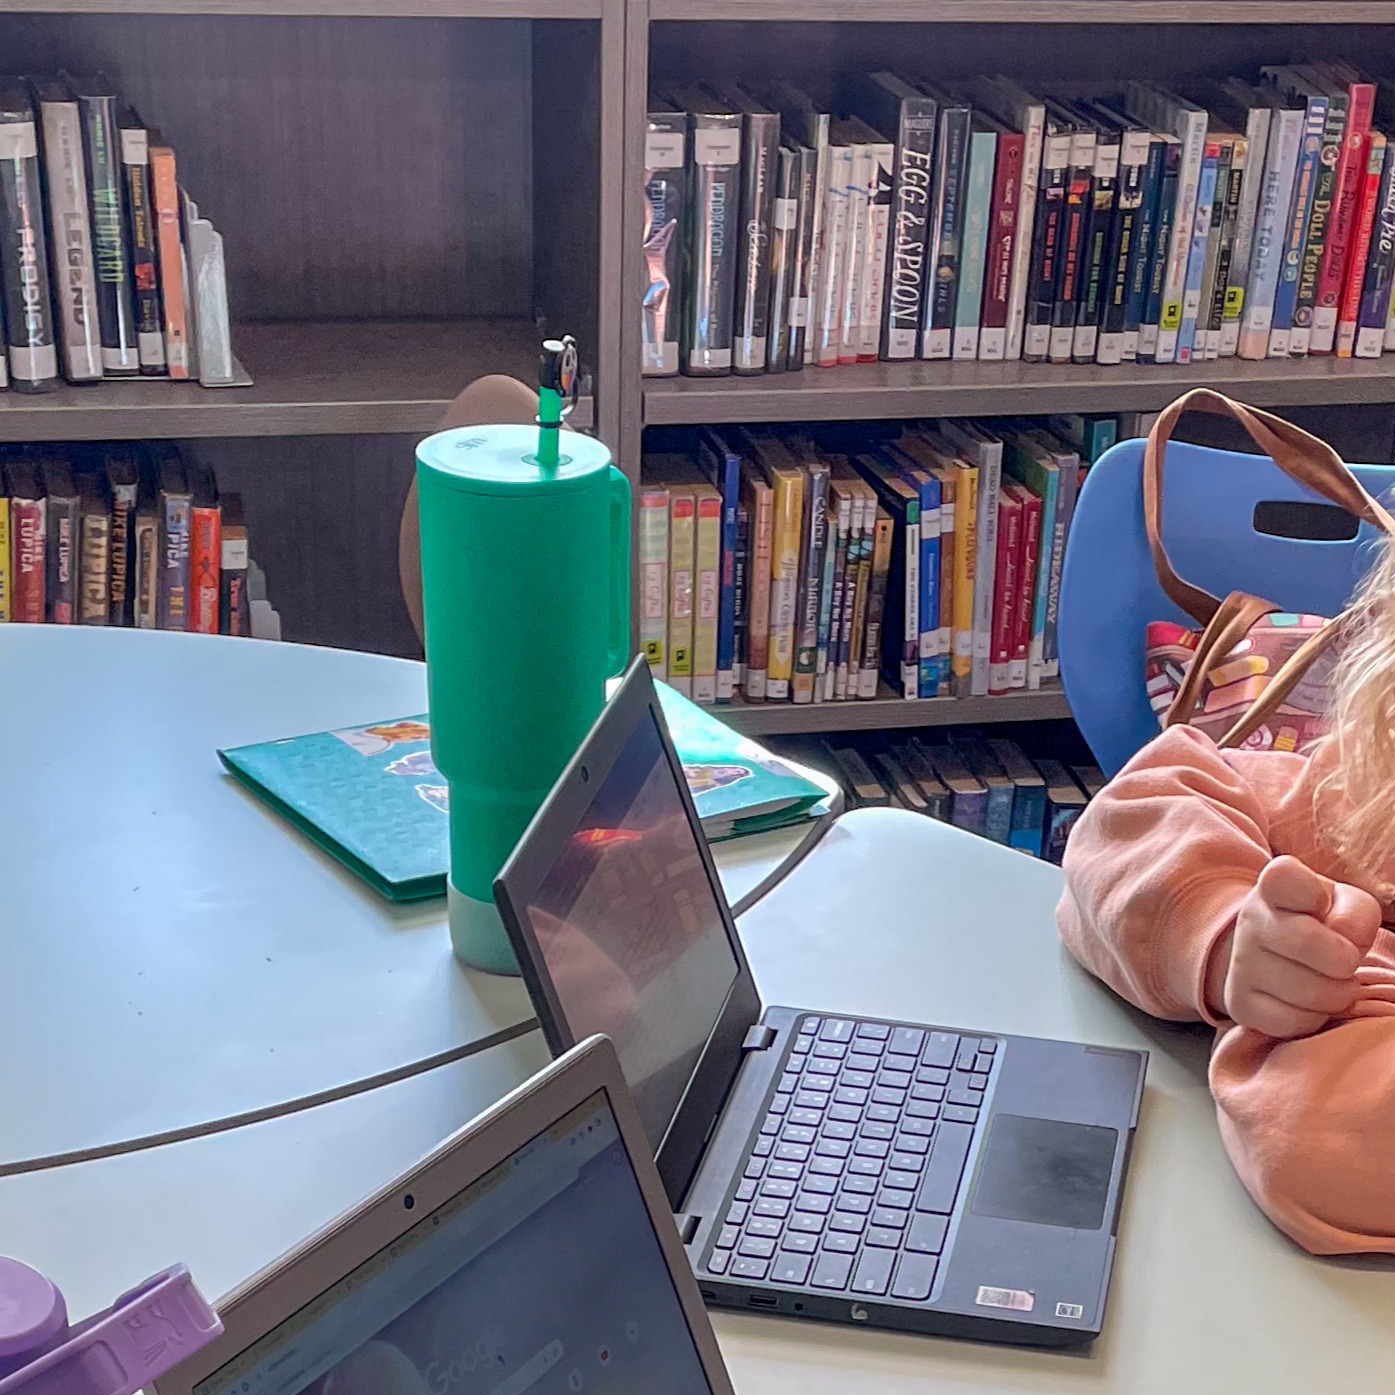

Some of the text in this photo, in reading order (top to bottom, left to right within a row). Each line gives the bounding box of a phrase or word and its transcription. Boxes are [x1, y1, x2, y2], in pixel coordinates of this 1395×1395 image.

[710, 183, 726, 257] PENDRAGON
[1229, 171, 1240, 203] MARTIN
[1308, 199, 1329, 240] DOLL
[93, 188, 124, 283] WILDCARD
[891, 147, 931, 321] EGG & SPOON
[1139, 224, 1150, 253] NIGHT
[1151, 224, 1168, 294] NIGHT TOURIST
[1254, 171, 1279, 283] HERE TODAY
[17, 228, 43, 347] PRODIGY
[64, 212, 84, 326] LEGEND
[1299, 244, 1322, 299] PEOPLE
[21, 519, 34, 572] LUPICA
[59, 547, 69, 582] LUPICA
[83, 520, 107, 618] LUPICA
[111, 542, 126, 602] LUPICA
[1048, 522, 1064, 623] HIDEAWAY
